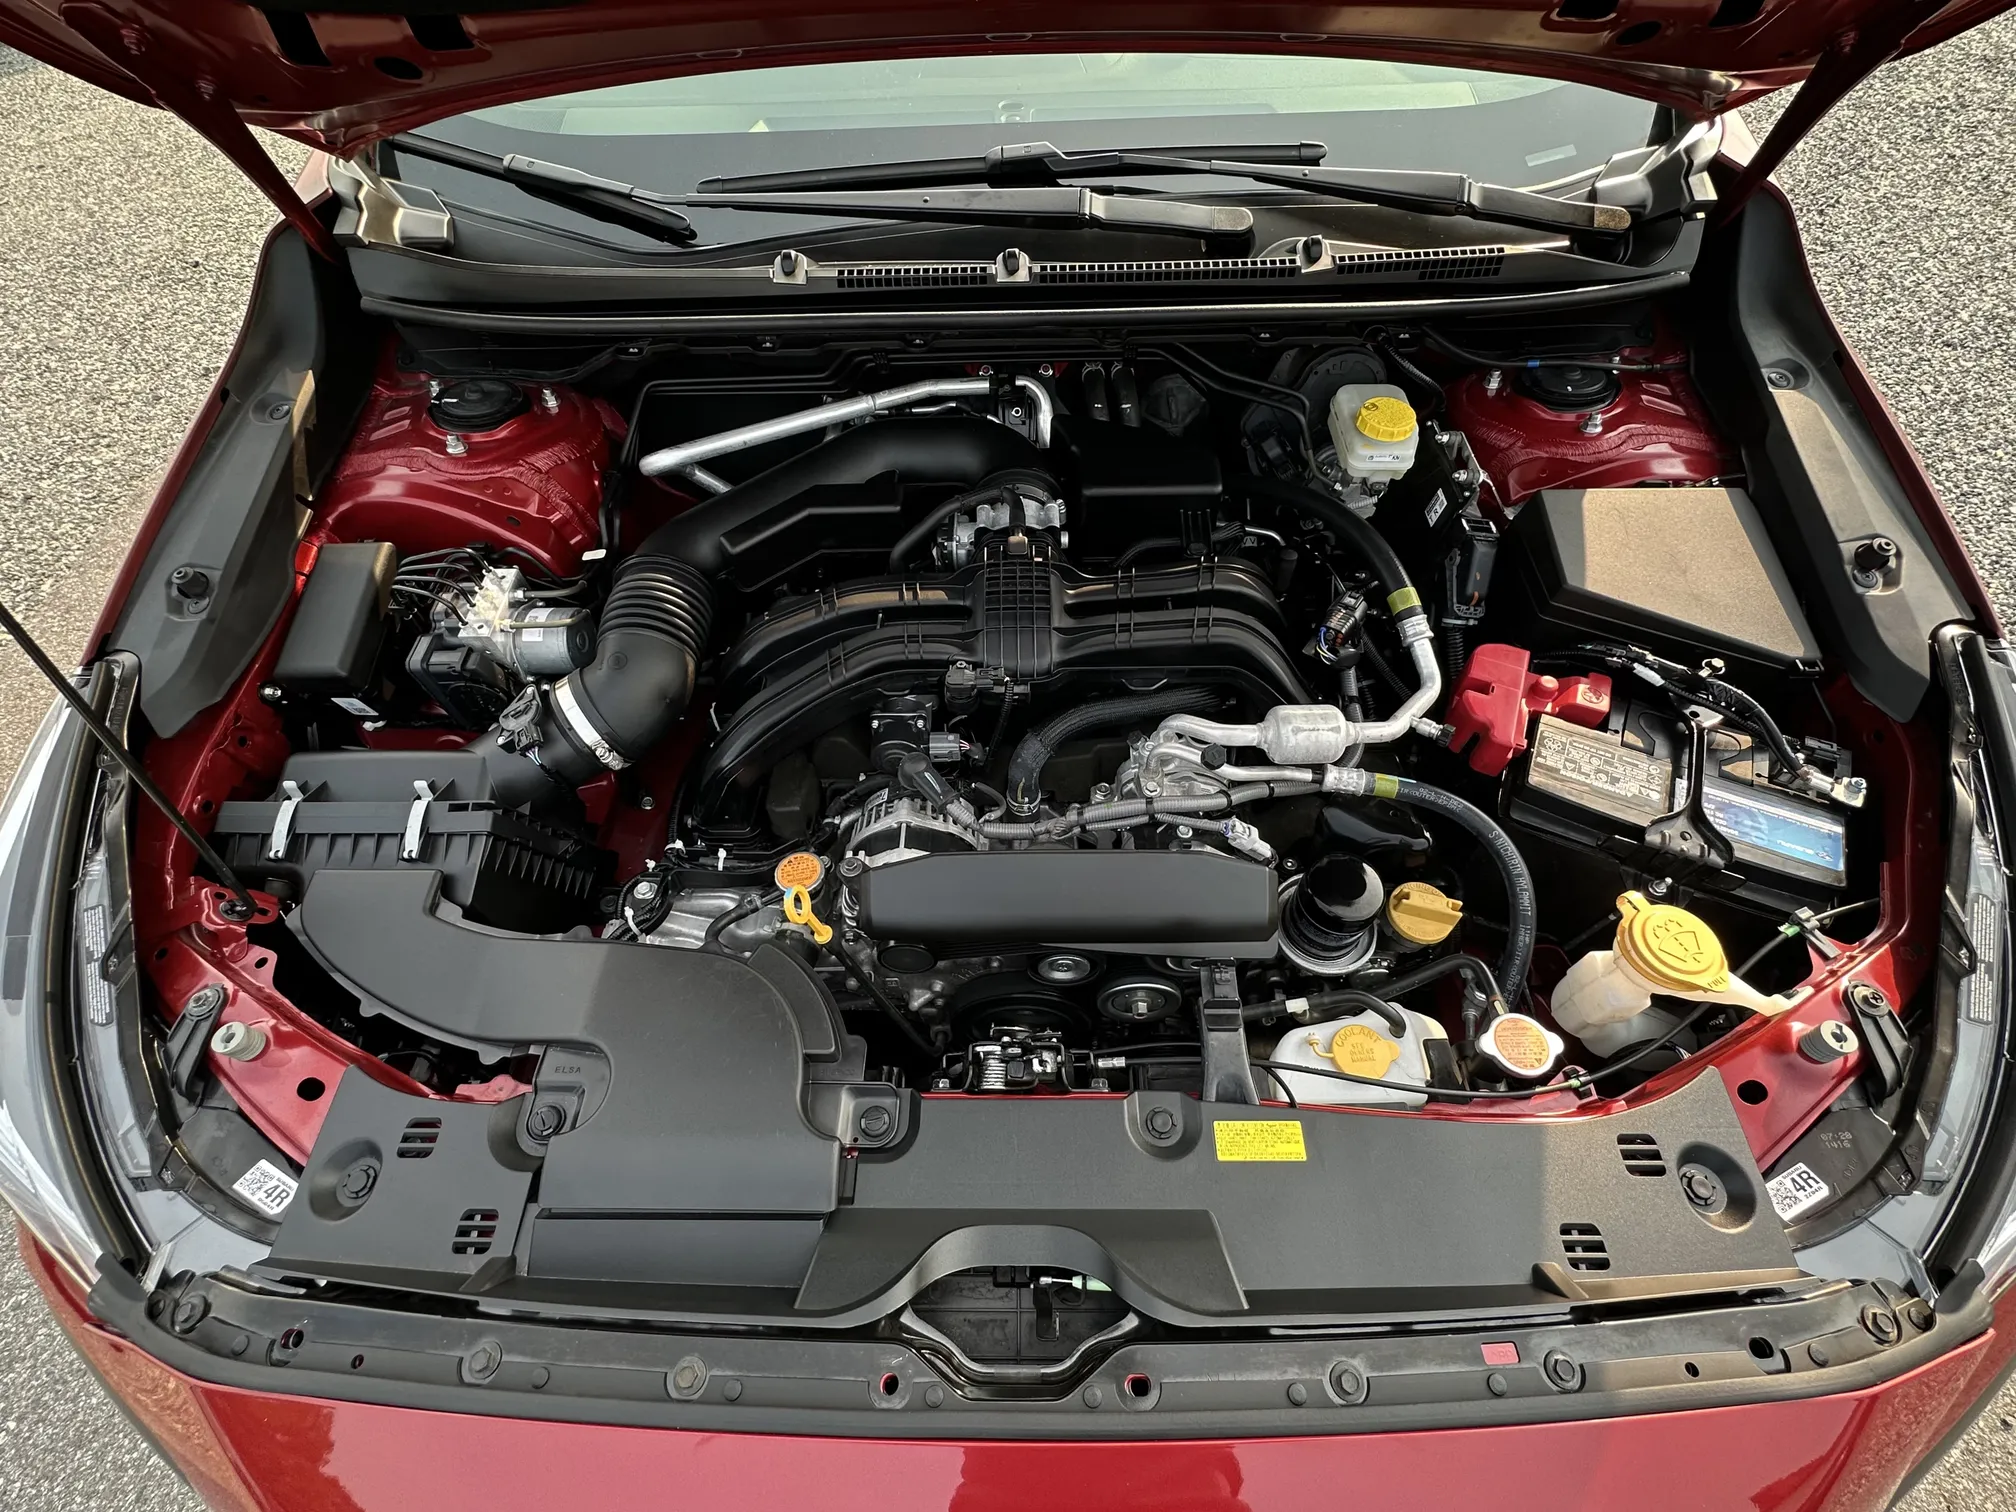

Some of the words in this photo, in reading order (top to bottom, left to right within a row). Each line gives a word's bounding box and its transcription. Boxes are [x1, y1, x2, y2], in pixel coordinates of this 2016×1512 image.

[1335, 1027, 1381, 1047] COOLANT
[554, 1066, 582, 1074] ELSA
[1825, 1140, 1851, 1149] 1416
[1782, 1165, 1802, 1180] SUBARU
[276, 1177, 295, 1192] SUBARU
[1790, 1169, 1821, 1193] 4R
[263, 1183, 291, 1208] 4R
